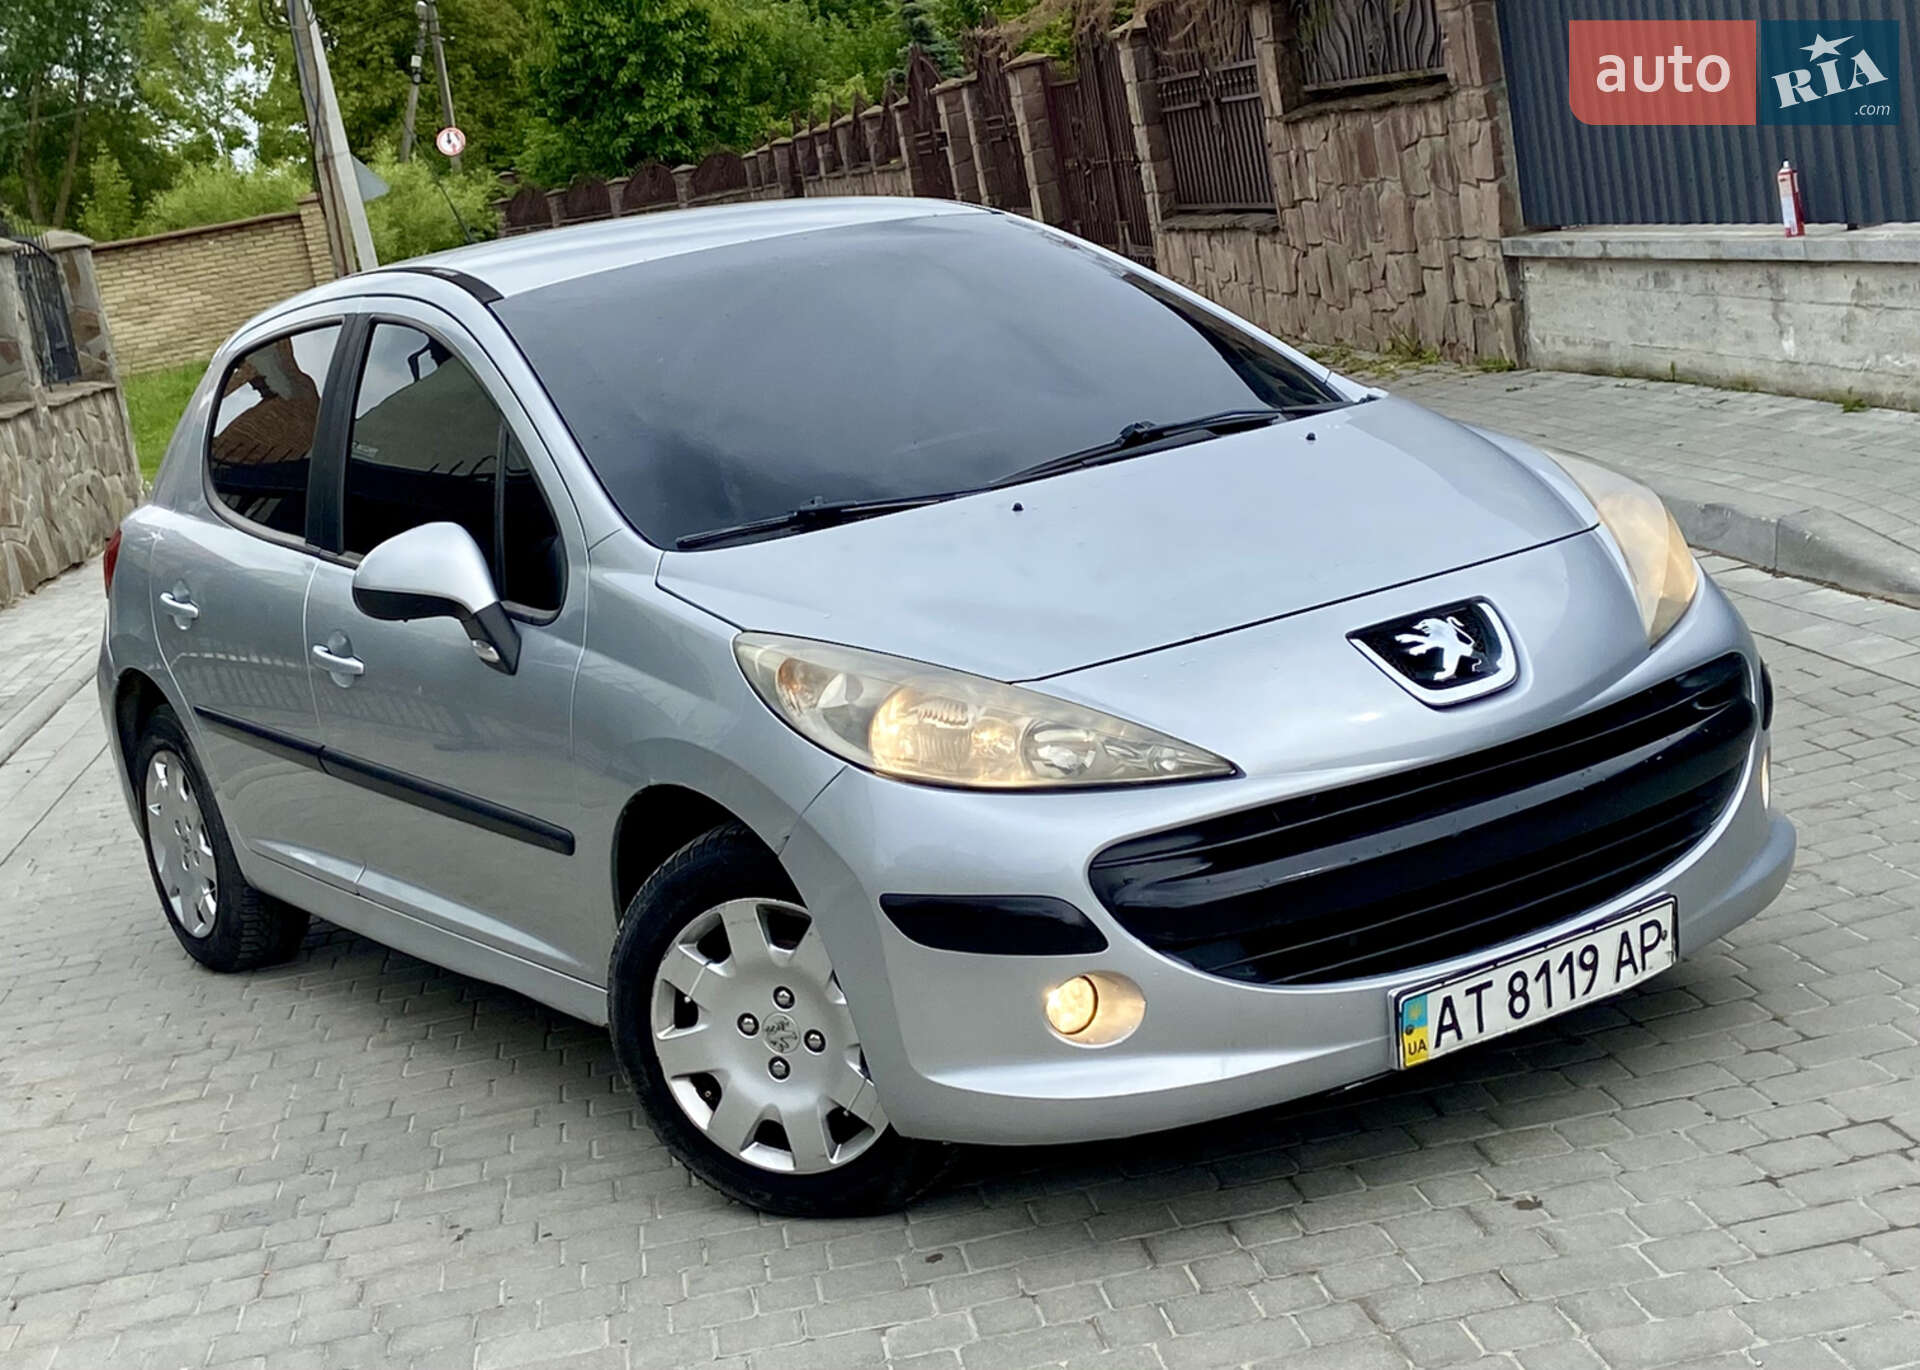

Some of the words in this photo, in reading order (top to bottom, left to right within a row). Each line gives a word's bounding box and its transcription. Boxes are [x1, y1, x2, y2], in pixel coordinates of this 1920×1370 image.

[1434, 979, 1493, 1049] AT
[1507, 944, 1600, 1020] 8119
[1615, 918, 1664, 983] AP
[1408, 1037, 1428, 1056] UA
